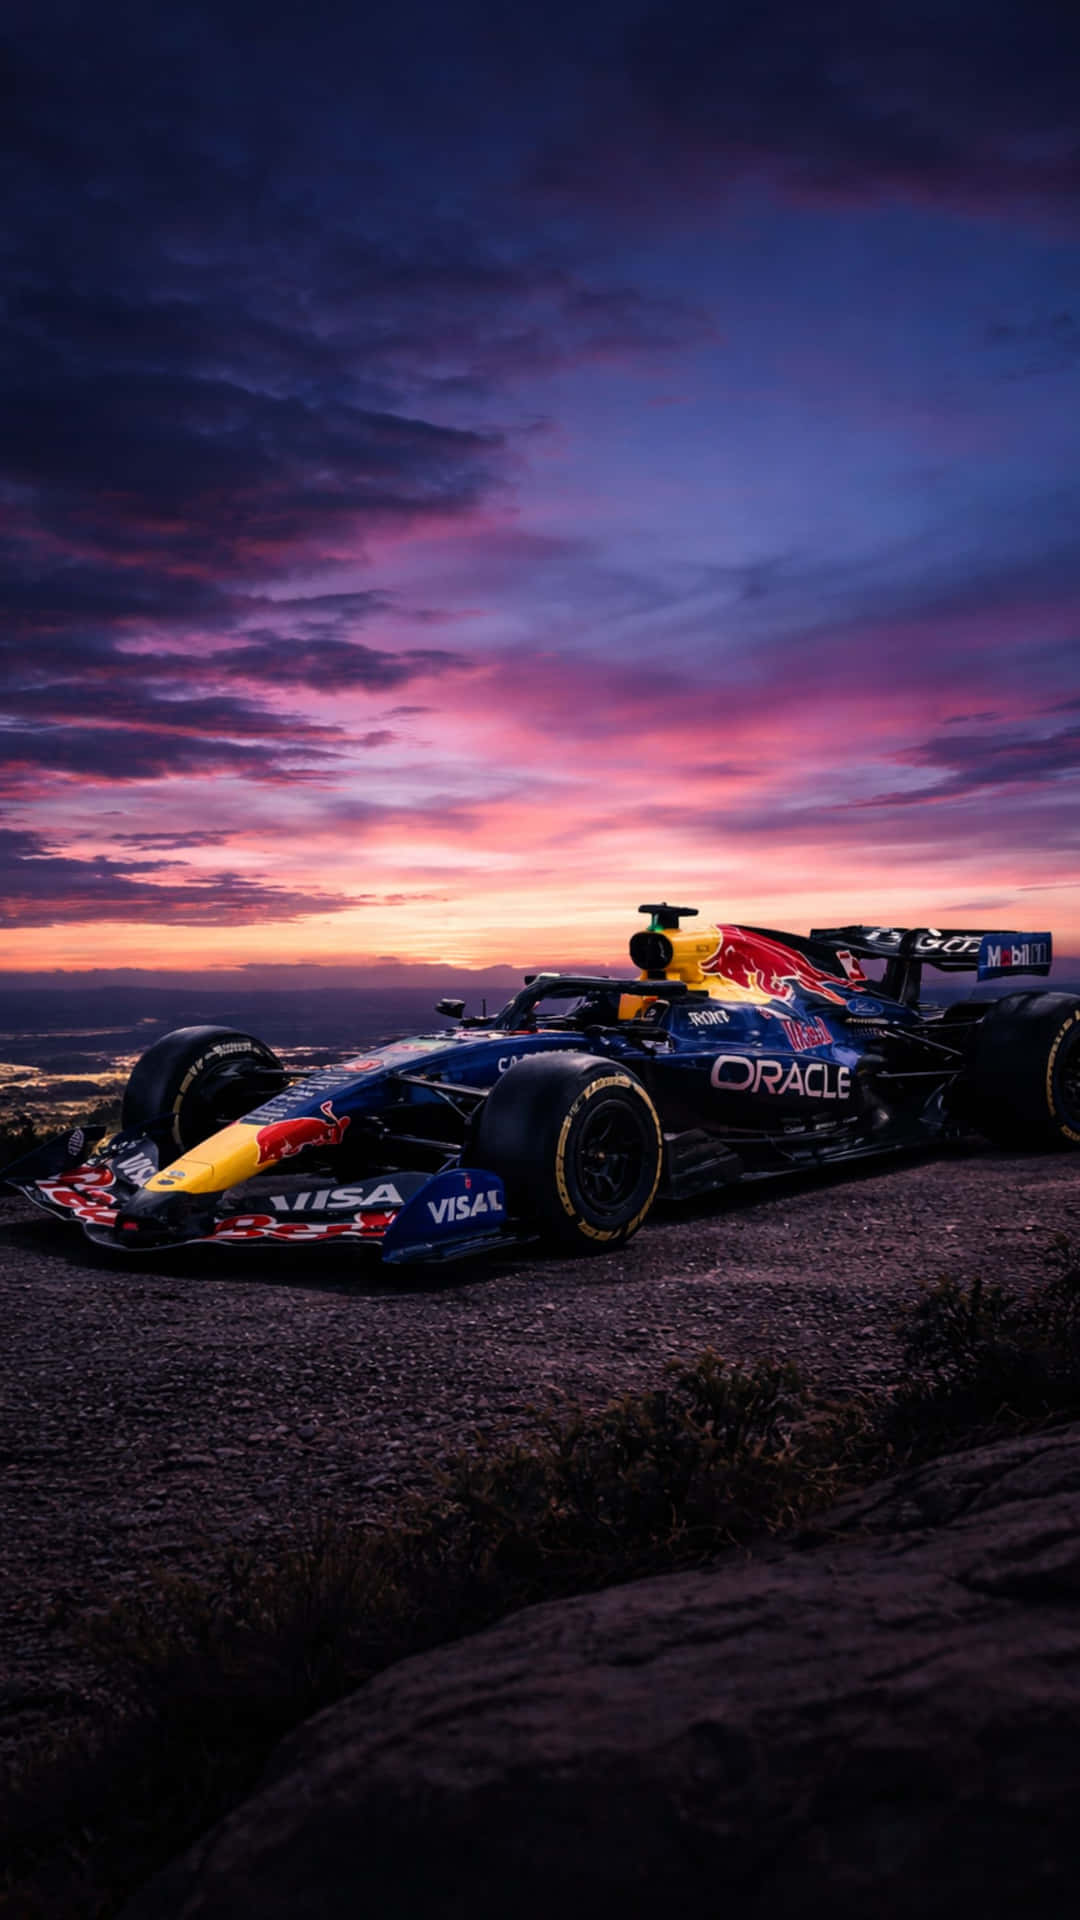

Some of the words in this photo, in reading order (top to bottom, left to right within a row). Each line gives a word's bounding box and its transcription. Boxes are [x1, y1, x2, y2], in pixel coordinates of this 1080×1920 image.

[987, 944, 1029, 968] Mobil
[711, 1054, 850, 1099] ORACLE
[269, 1184, 405, 1211] VISA
